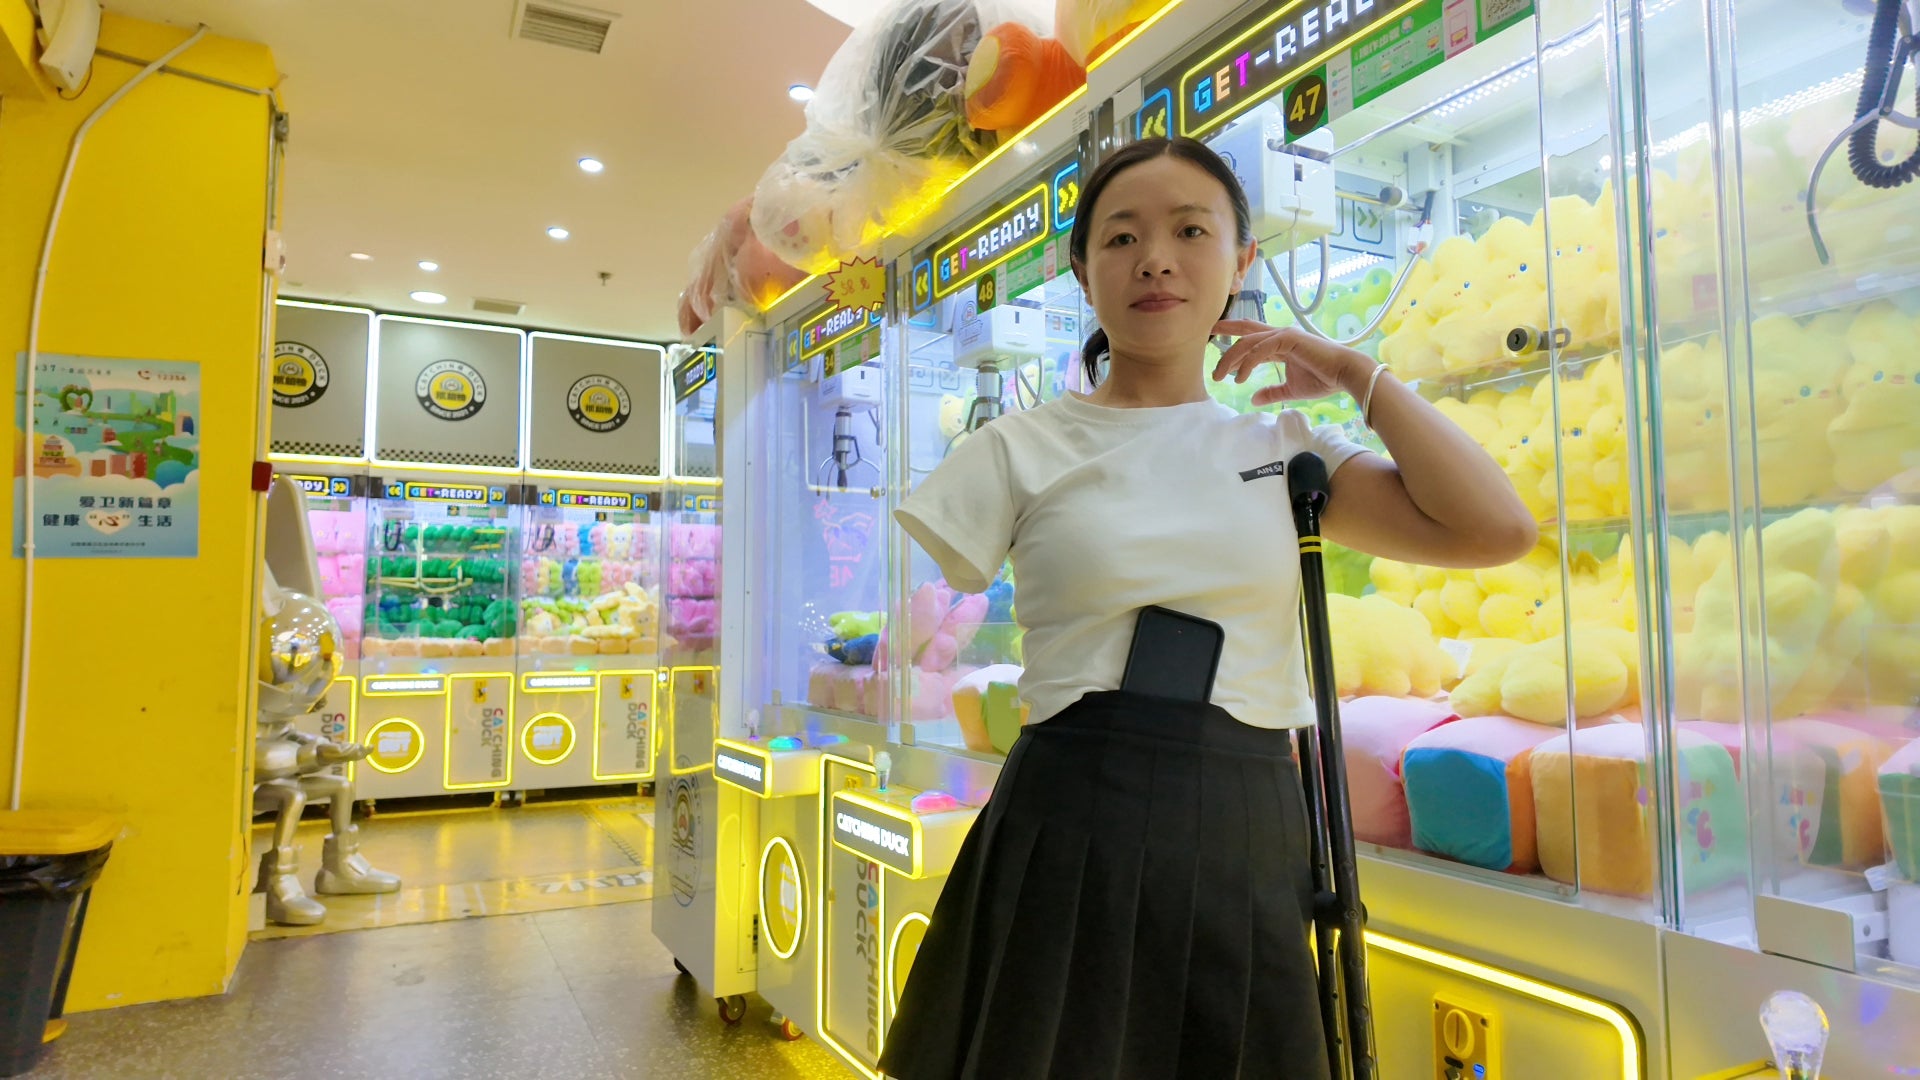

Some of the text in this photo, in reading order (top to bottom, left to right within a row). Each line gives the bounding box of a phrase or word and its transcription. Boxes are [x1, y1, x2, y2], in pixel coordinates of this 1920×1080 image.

[1290, 83, 1321, 122] 47
[941, 203, 1039, 281] GET-READY
[979, 281, 993, 302] 48
[825, 353, 834, 371] 34
[1257, 466, 1273, 476] AIN
[79, 496, 172, 509] 爱卫新篇章
[410, 487, 483, 500] GET-READY
[562, 494, 627, 507] GET-READY
[481, 708, 493, 747] DUCK
[626, 702, 638, 740] DUCK
[635, 703, 647, 769] CATCHING
[491, 708, 504, 778] CATCHING
[836, 812, 909, 857] CATCHING DUCK
[856, 857, 867, 959] DUCK
[866, 861, 880, 1057] CATCHING
